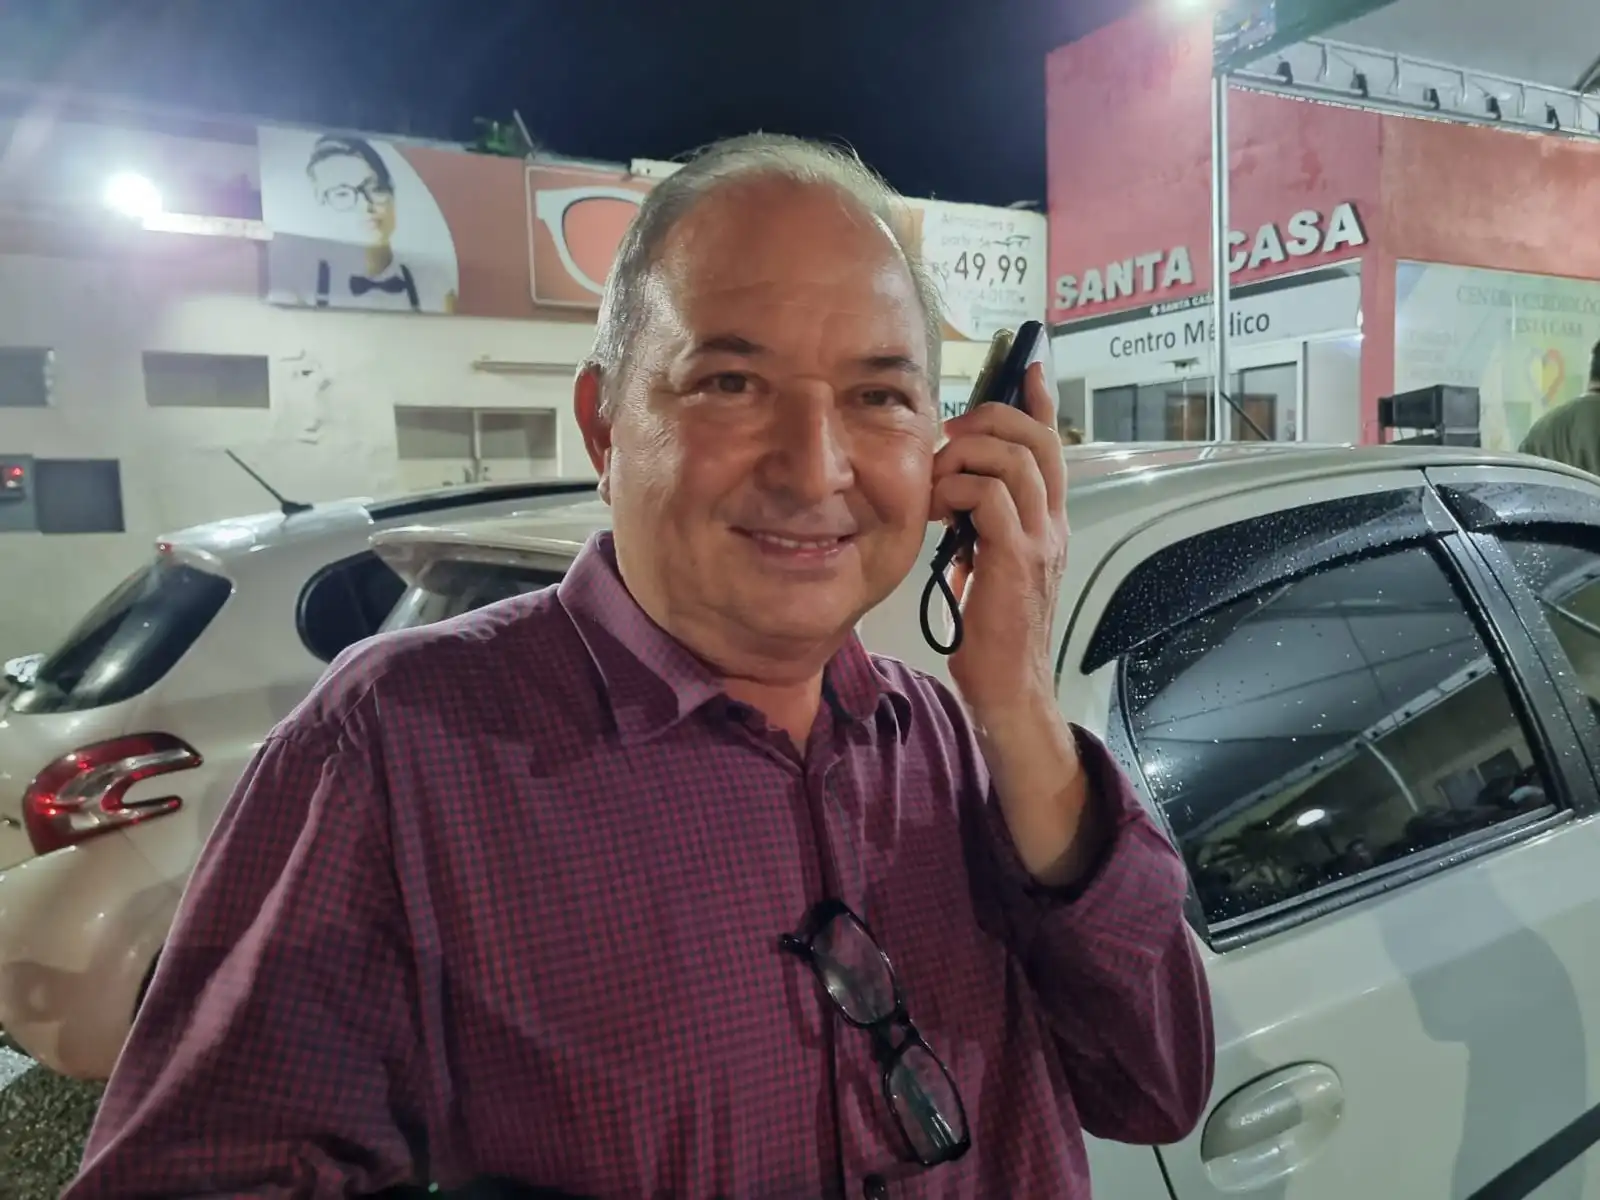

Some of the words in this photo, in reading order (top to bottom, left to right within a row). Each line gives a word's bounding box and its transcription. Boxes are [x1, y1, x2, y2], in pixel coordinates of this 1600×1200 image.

[954, 250, 1028, 287] 49,99
[1054, 246, 1195, 311] SANTA
[1229, 202, 1369, 274] CASA
[1110, 331, 1177, 359] Centro
[1184, 311, 1271, 347] Méico
